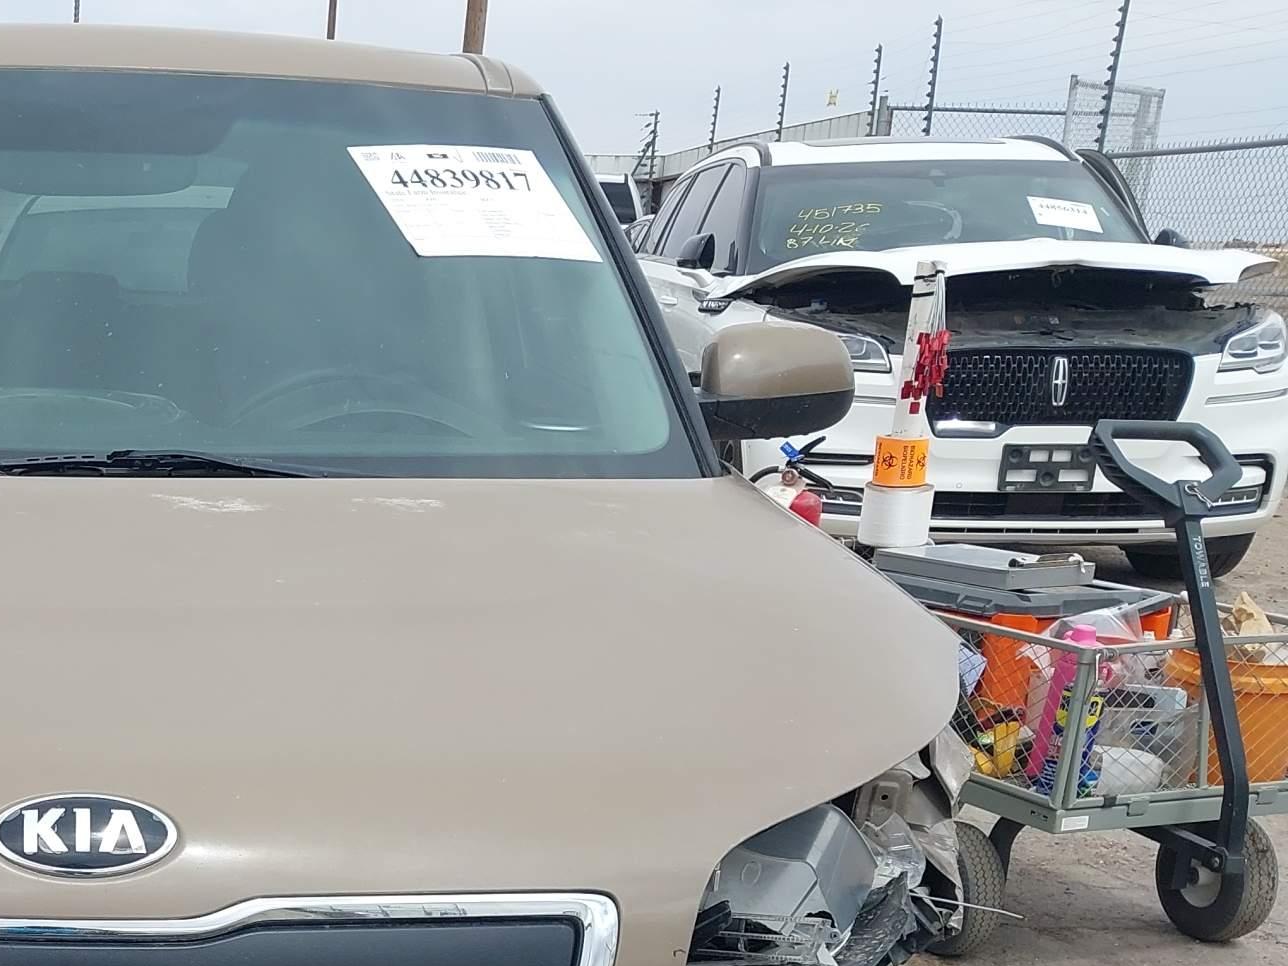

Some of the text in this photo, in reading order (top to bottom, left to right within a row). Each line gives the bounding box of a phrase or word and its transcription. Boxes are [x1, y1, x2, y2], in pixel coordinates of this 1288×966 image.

[391, 168, 531, 192] 44839817
[797, 203, 883, 221] 451735
[906, 445, 916, 480] BIOHAZARD
[1192, 535, 1210, 588] TOWABLE
[21, 807, 148, 855] KIA
